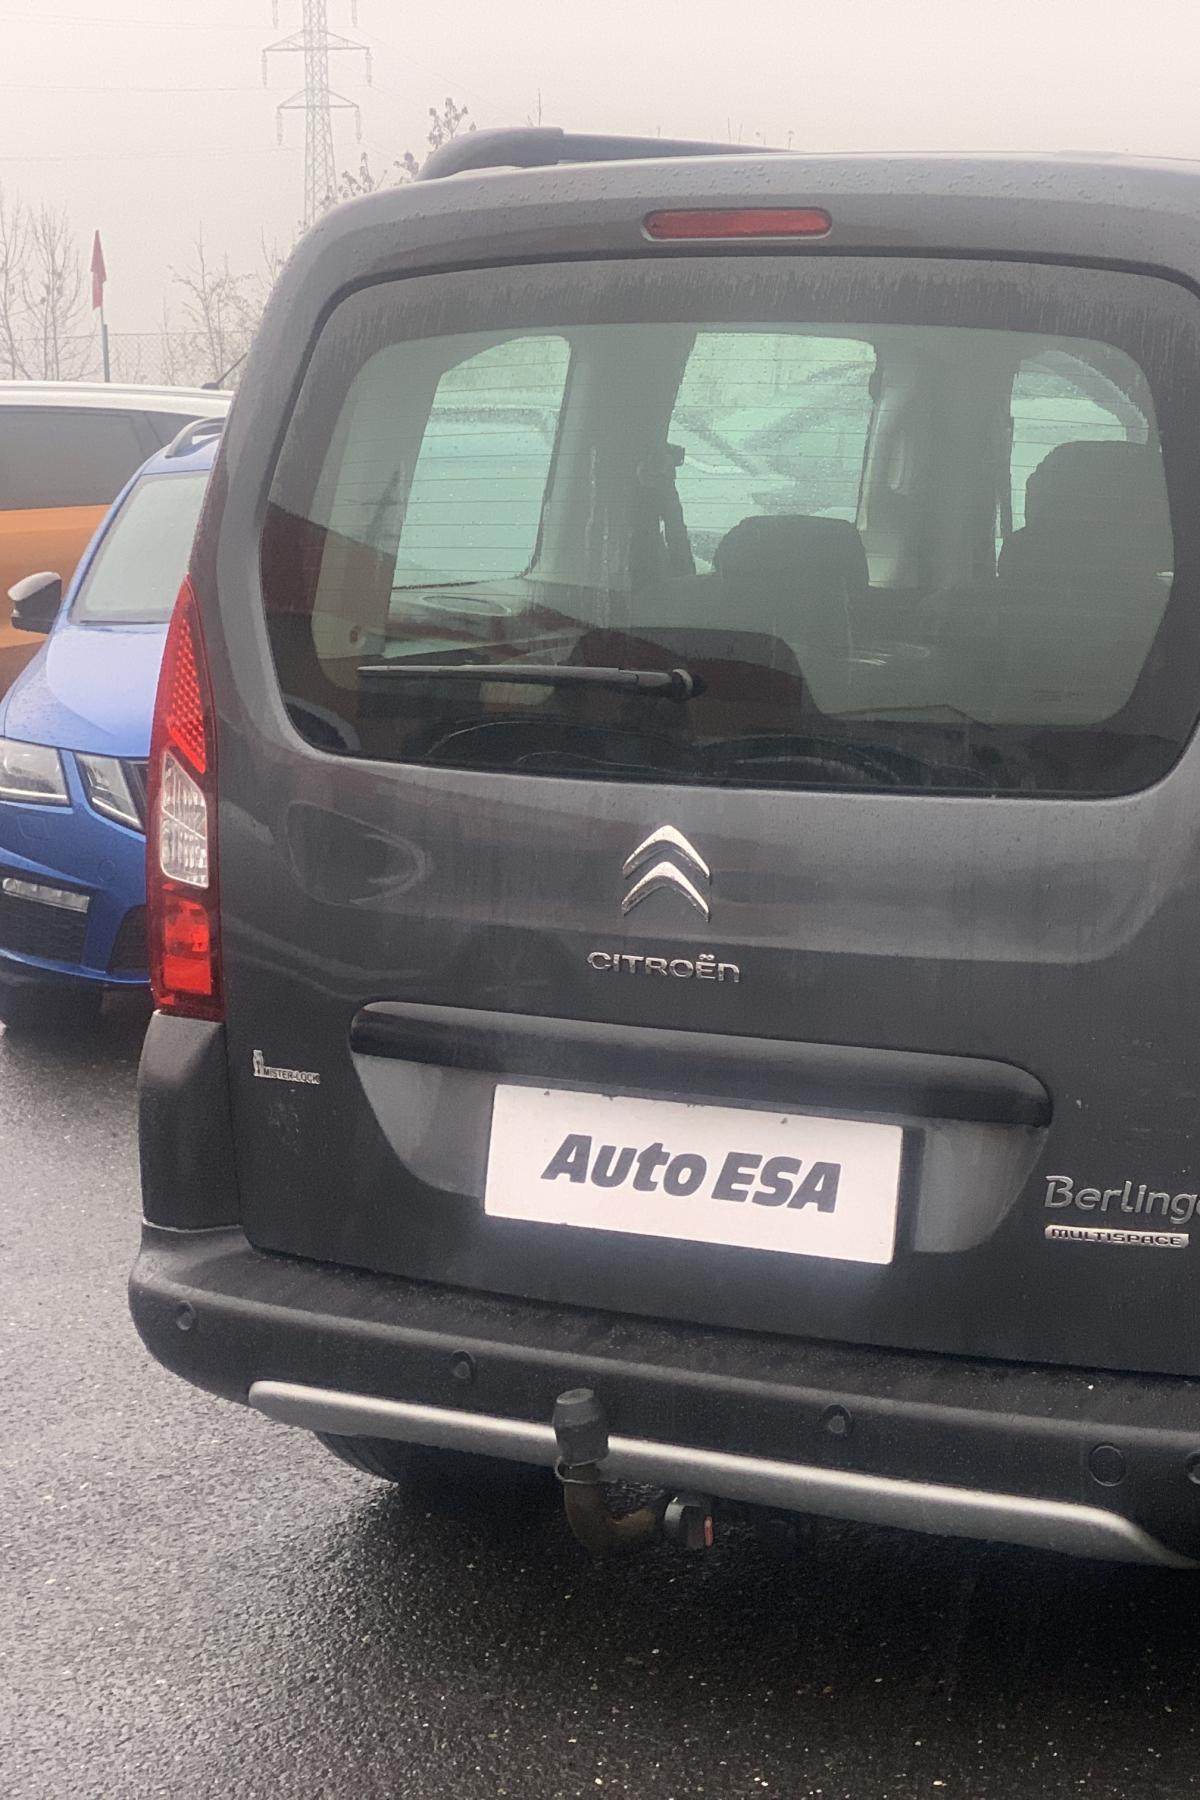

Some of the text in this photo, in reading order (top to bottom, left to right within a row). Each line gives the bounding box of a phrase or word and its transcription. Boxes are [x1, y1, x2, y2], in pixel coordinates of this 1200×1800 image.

[541, 1133, 842, 1214] Auto ESA
[1051, 1227, 1183, 1247] MULTISPACE
